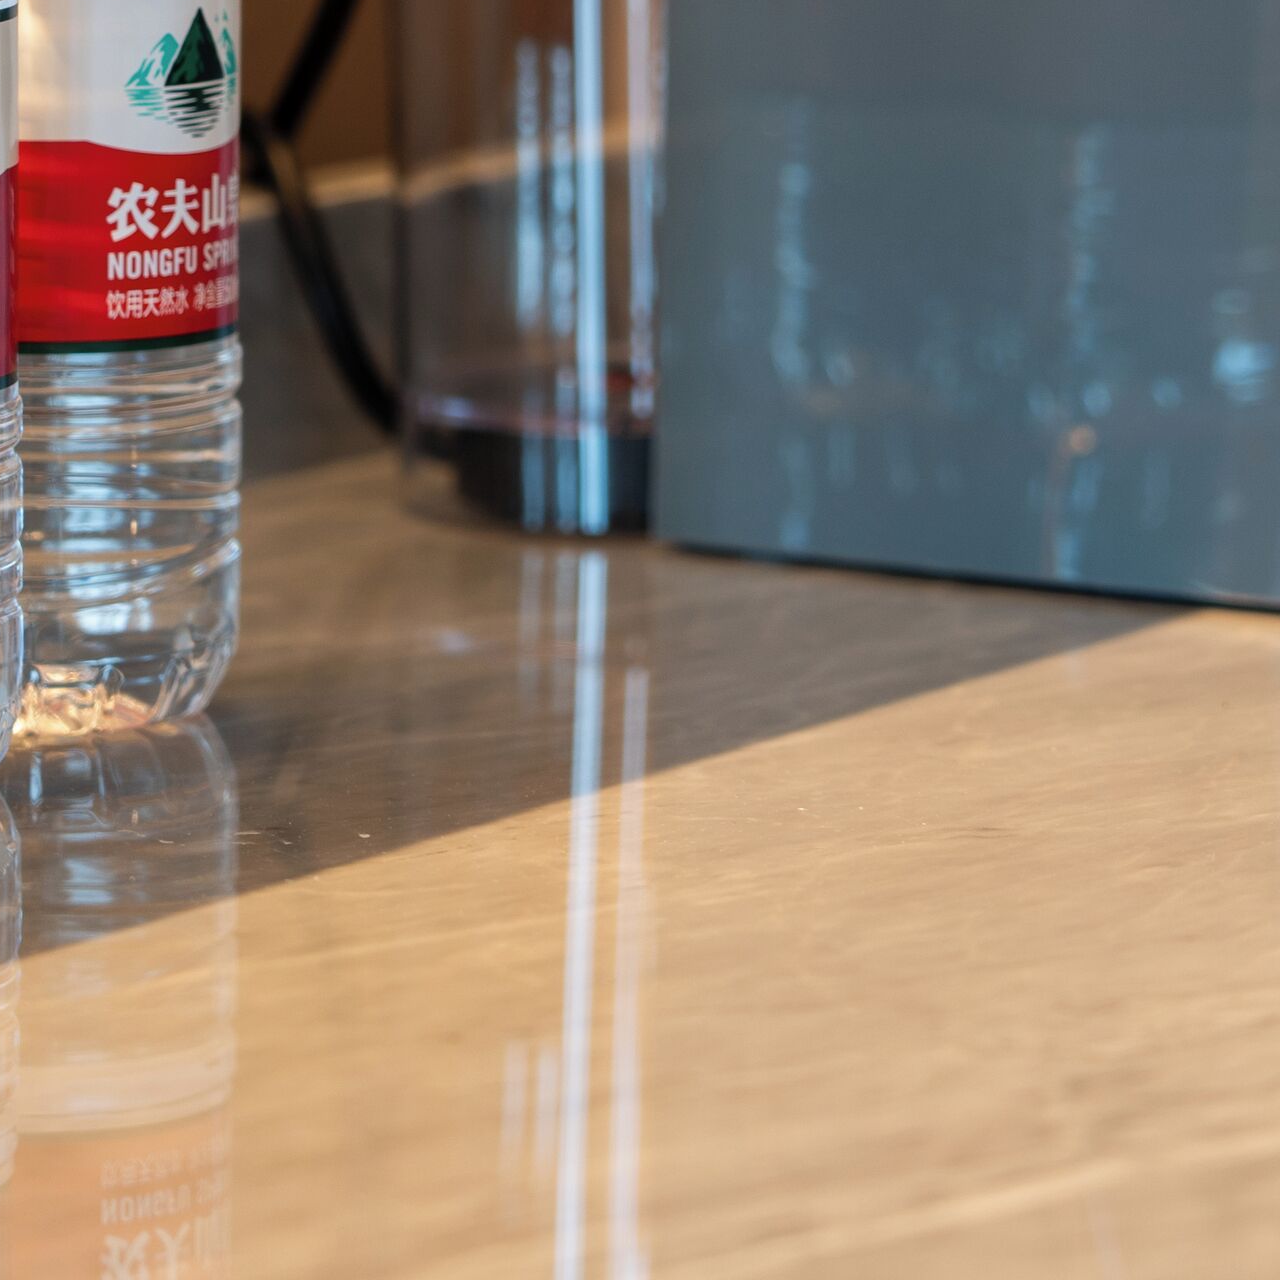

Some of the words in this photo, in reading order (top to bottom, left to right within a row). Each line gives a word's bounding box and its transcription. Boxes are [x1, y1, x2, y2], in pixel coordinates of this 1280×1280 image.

[107, 245, 198, 280] NONGFU
[106, 285, 189, 319] 饮用天然水
